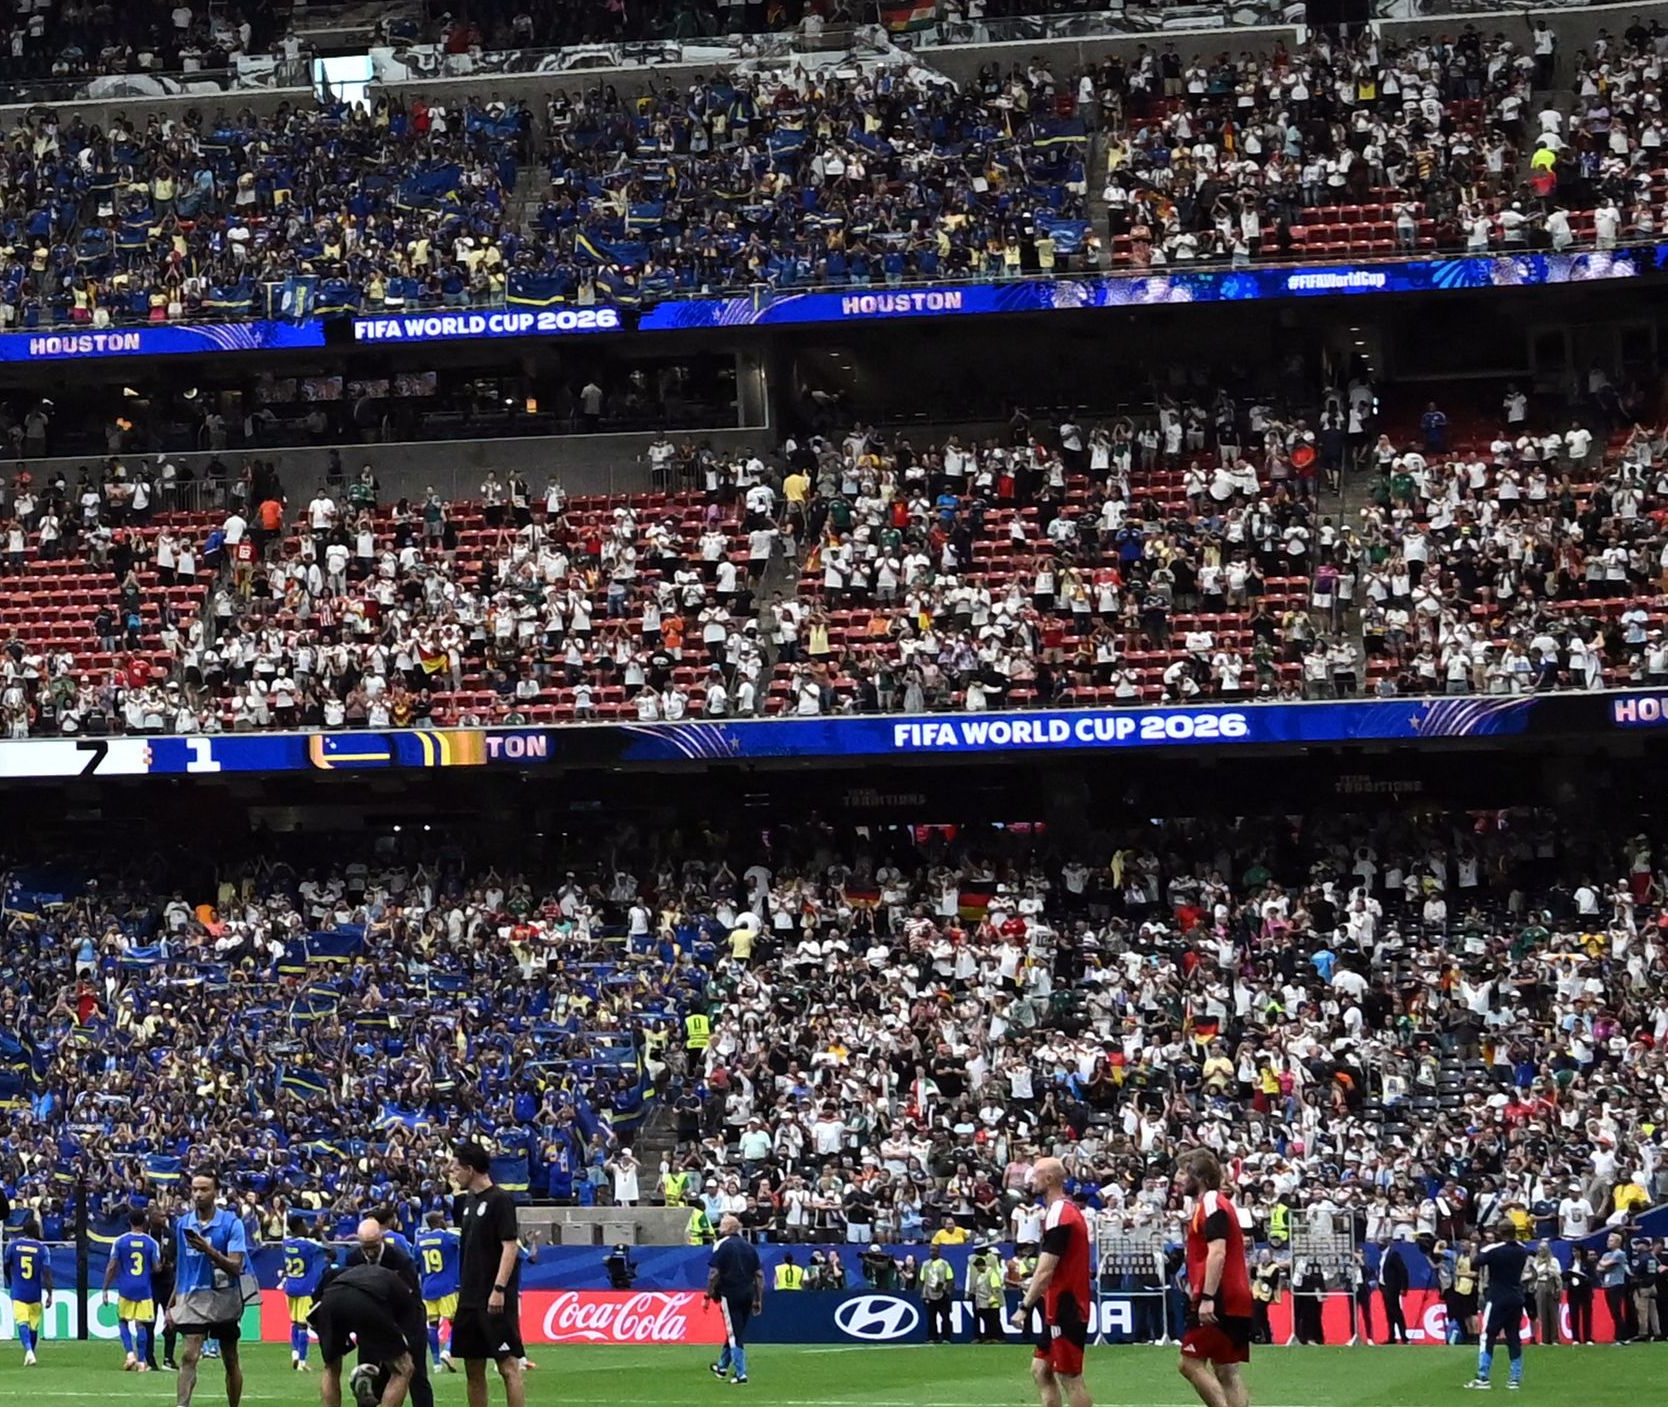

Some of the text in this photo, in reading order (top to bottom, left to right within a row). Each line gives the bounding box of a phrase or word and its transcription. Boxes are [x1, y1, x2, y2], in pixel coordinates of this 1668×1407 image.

[1287, 270, 1386, 292] #FIFAWorldCup
[842, 291, 962, 316] HOUSTON
[354, 308, 617, 340] FIFA WORLD CUP 2026
[30, 332, 141, 356] HOUSTON
[894, 712, 1248, 747] FIFA WORLD CUP 2026
[76, 741, 109, 777] 7
[186, 738, 221, 773] 1
[20, 1256, 33, 1280] 5
[130, 1252, 143, 1276] 3
[422, 1248, 443, 1274] 19
[543, 1291, 695, 1341] Coca-Cola
